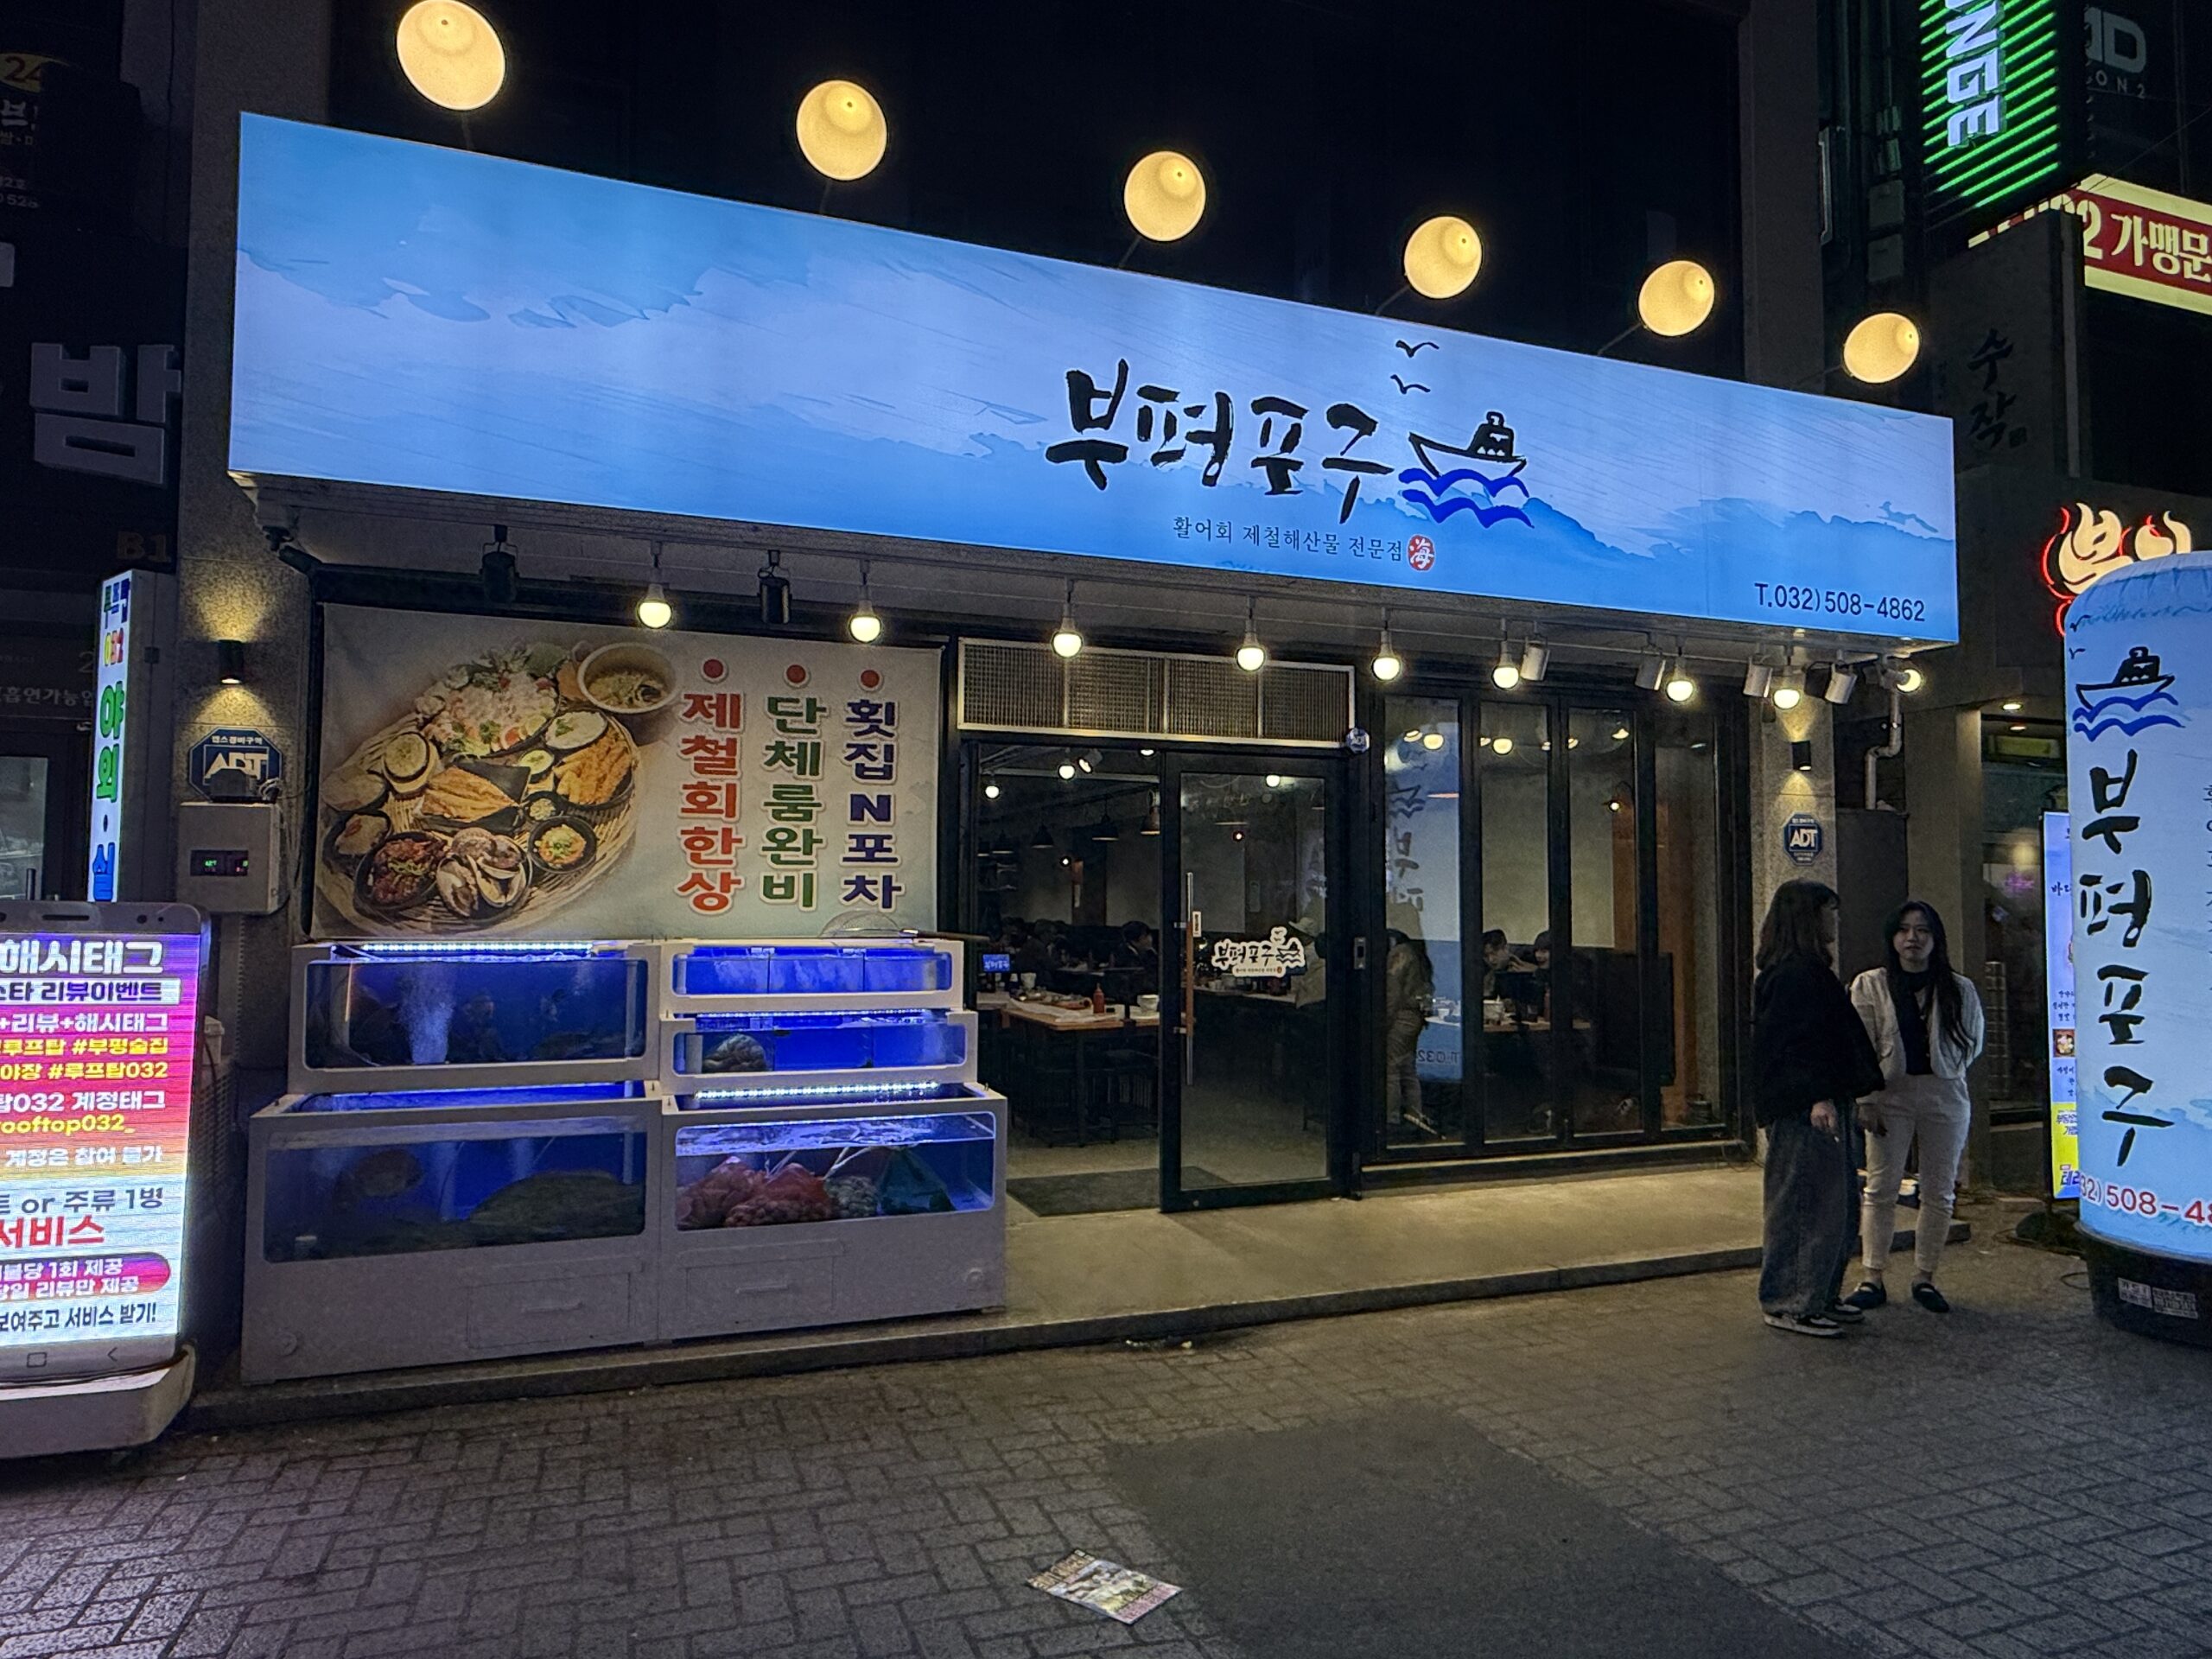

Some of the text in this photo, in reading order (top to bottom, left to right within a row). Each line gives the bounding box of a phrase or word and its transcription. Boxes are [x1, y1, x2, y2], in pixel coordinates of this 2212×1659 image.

[1944, 0, 2001, 147] NGE
[2110, 212, 2212, 283] 가맹문
[1046, 358, 1394, 524] 부평포구
[116, 531, 171, 563] B1
[1173, 516, 1232, 542] 활어회
[1243, 524, 1340, 555] 제철해산물
[1349, 536, 1402, 562] 전문점
[204, 751, 269, 780] ADT
[1789, 828, 1818, 848] ADT
[0, 939, 163, 974] 해시태그
[1215, 942, 1275, 966] 부평포구
[2080, 748, 2175, 1166] 부평포구
[41, 982, 162, 1002] 리뷰이벤트
[0, 1039, 67, 1056] 루프탑
[48, 1062, 168, 1080] #루프탑032
[72, 1090, 166, 1111] 계정태그
[0, 1114, 136, 1136] ooftop032_
[6, 1148, 69, 1166] 계정은
[75, 1147, 116, 1165] 참여
[22, 1198, 55, 1214] or
[63, 1190, 116, 1213] 주류
[125, 1187, 163, 1210] 1병
[0, 1214, 105, 1248] 서비스
[49, 1261, 79, 1279] 1회
[84, 1258, 124, 1276] 제공
[35, 1279, 95, 1298] 리뷰만
[100, 1275, 140, 1294] 제공
[65, 1306, 114, 1328] 서비스
[120, 1302, 157, 1325] 받기!
